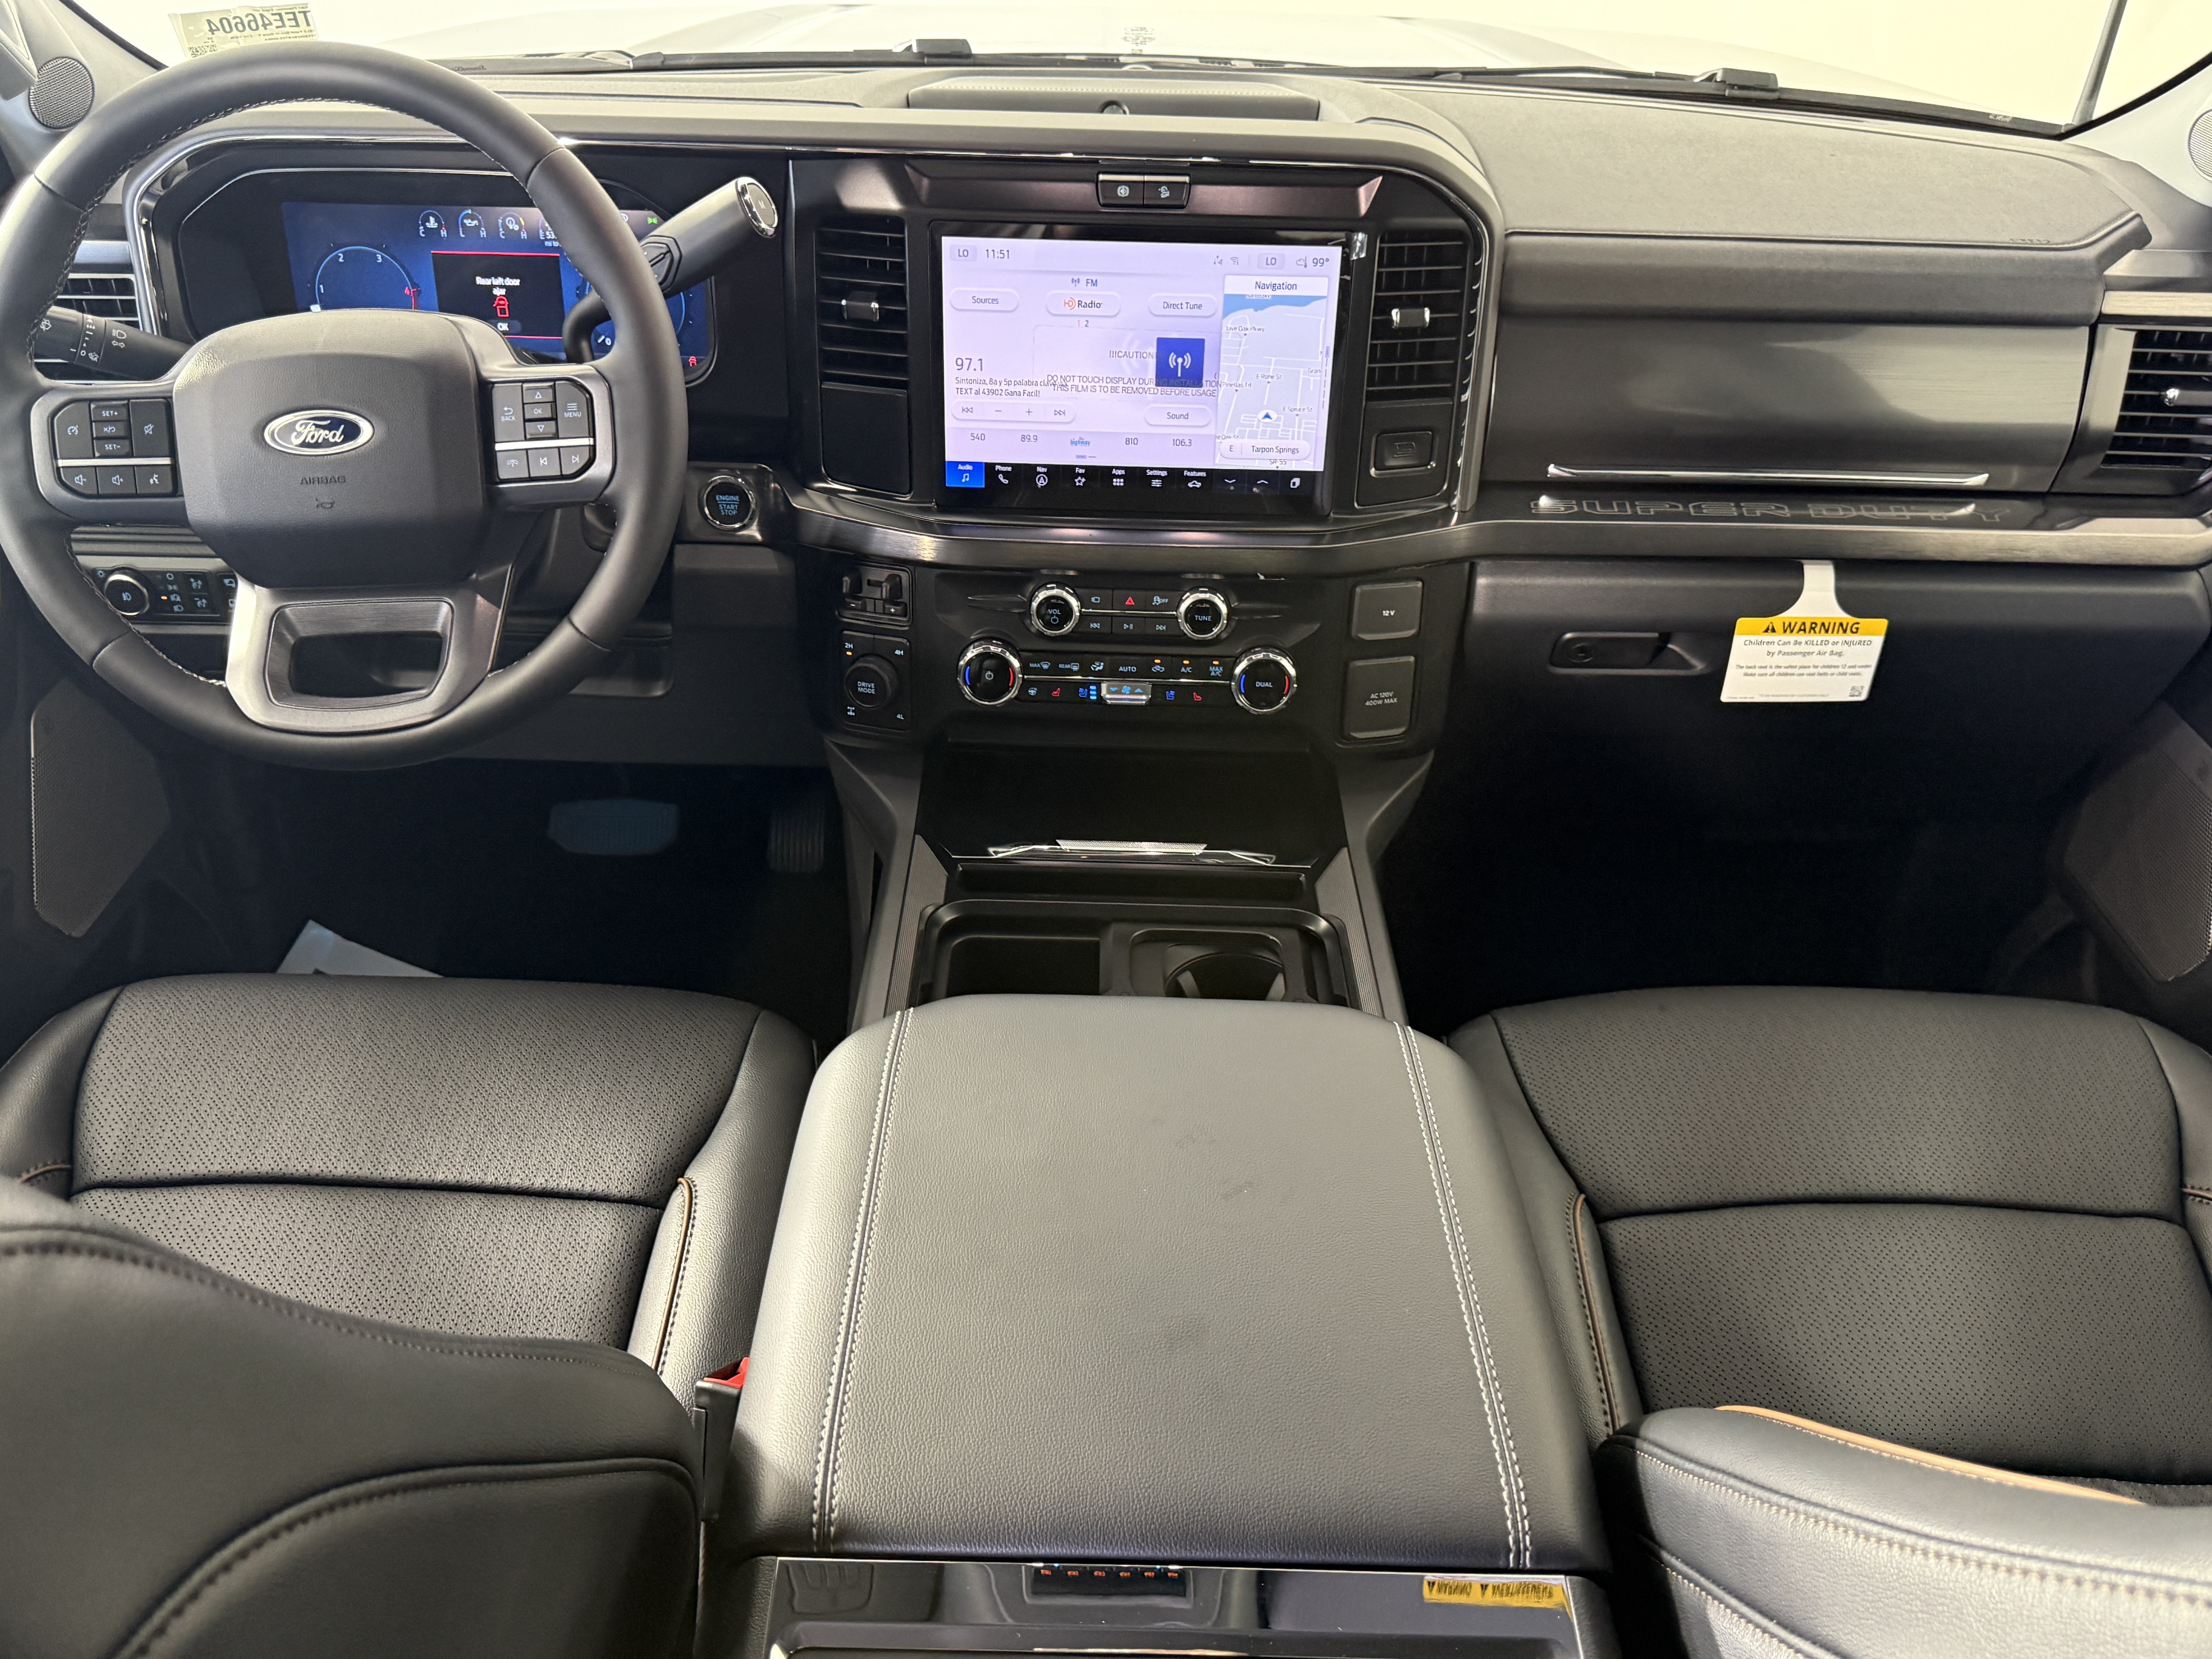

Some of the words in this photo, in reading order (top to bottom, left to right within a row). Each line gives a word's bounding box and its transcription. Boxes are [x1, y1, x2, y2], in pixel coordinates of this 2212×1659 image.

[521, 230, 527, 239] H
[338, 253, 344, 262] 2
[958, 249, 969, 258] LO
[986, 249, 1010, 259] 11:51
[376, 254, 382, 263] 3
[1266, 257, 1277, 266] LO
[1312, 257, 1330, 267] 99°
[476, 276, 491, 285] Rear
[1086, 279, 1098, 287] FM
[1255, 281, 1297, 290] Navigation
[972, 295, 999, 304] Sources
[1078, 300, 1101, 309] Radio
[497, 322, 509, 331] OK
[955, 357, 983, 371] 97.1
[1122, 386, 1159, 395] REMOVED
[291, 420, 344, 446] Ford
[1251, 445, 1274, 453] Tarpon
[1275, 446, 1299, 454] Springs
[301, 476, 346, 484] AIRBAG
[1530, 500, 1790, 517] SUPER
[1807, 503, 2010, 522] DUTY
[1782, 622, 1860, 634] WARNING
